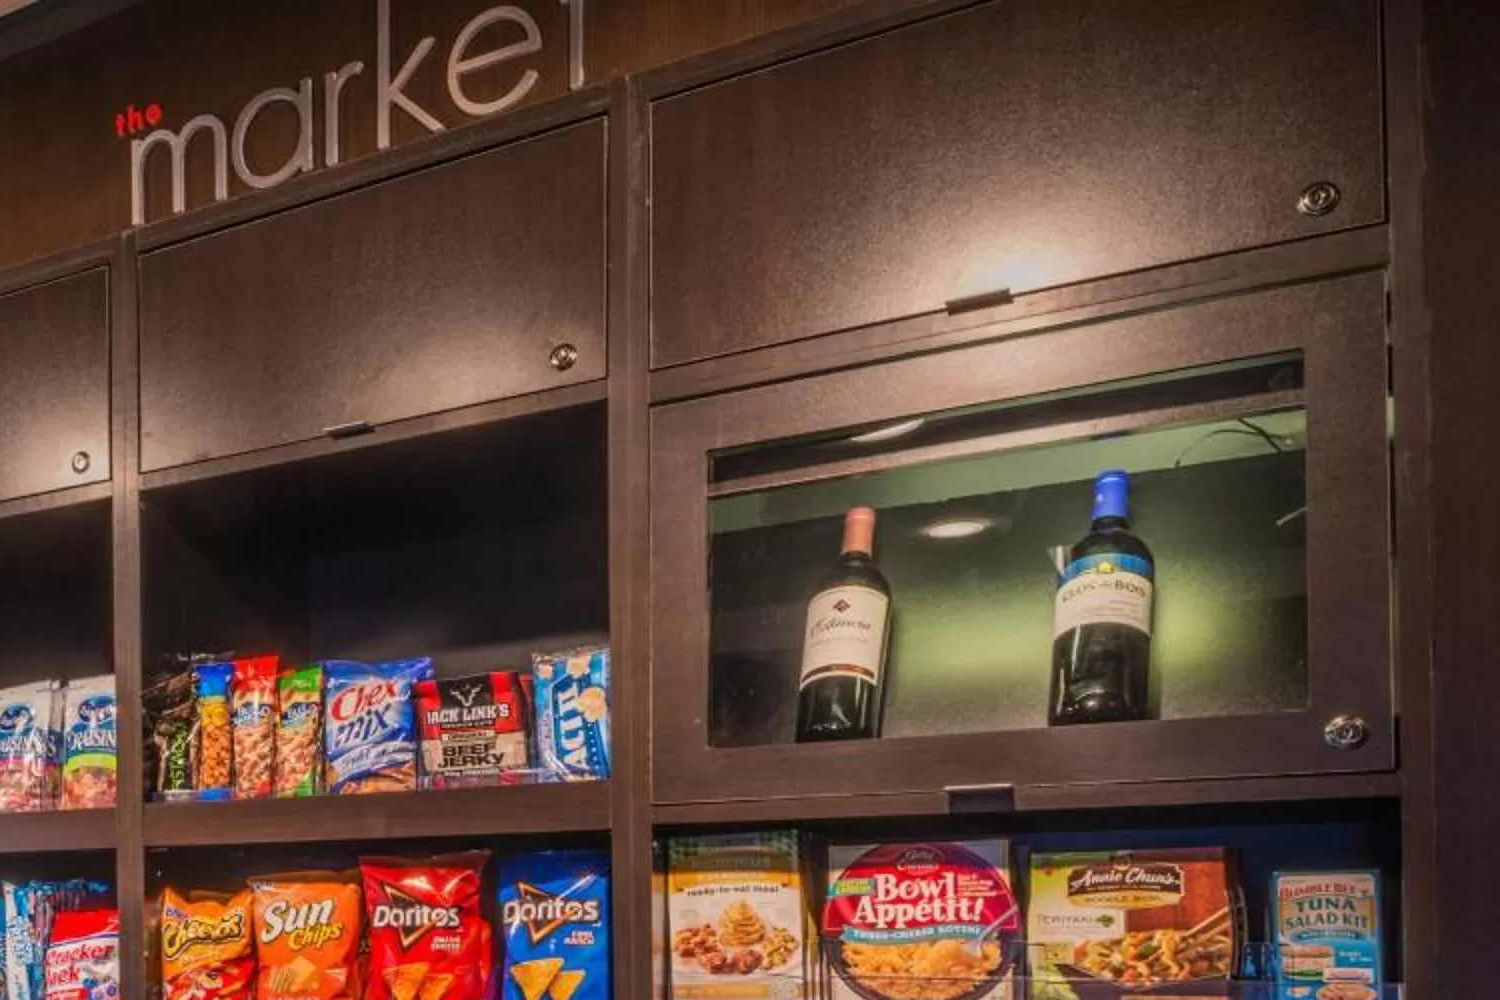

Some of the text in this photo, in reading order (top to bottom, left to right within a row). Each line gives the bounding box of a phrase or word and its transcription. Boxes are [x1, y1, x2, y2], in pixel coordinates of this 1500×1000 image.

[115, 103, 163, 138] the
[331, 679, 399, 722] Chex
[427, 708, 460, 725] JACK
[438, 751, 505, 768] JERKY
[442, 743, 497, 757] BEEF
[873, 872, 956, 901] Bowl
[1075, 866, 1181, 887] Annie Chun's
[373, 904, 461, 928] Doritos
[503, 898, 600, 925] Doritos
[1296, 896, 1358, 913] TUNA
[260, 899, 334, 943] Sun
[1285, 911, 1336, 929] SALAD
[287, 922, 344, 952] Chips
